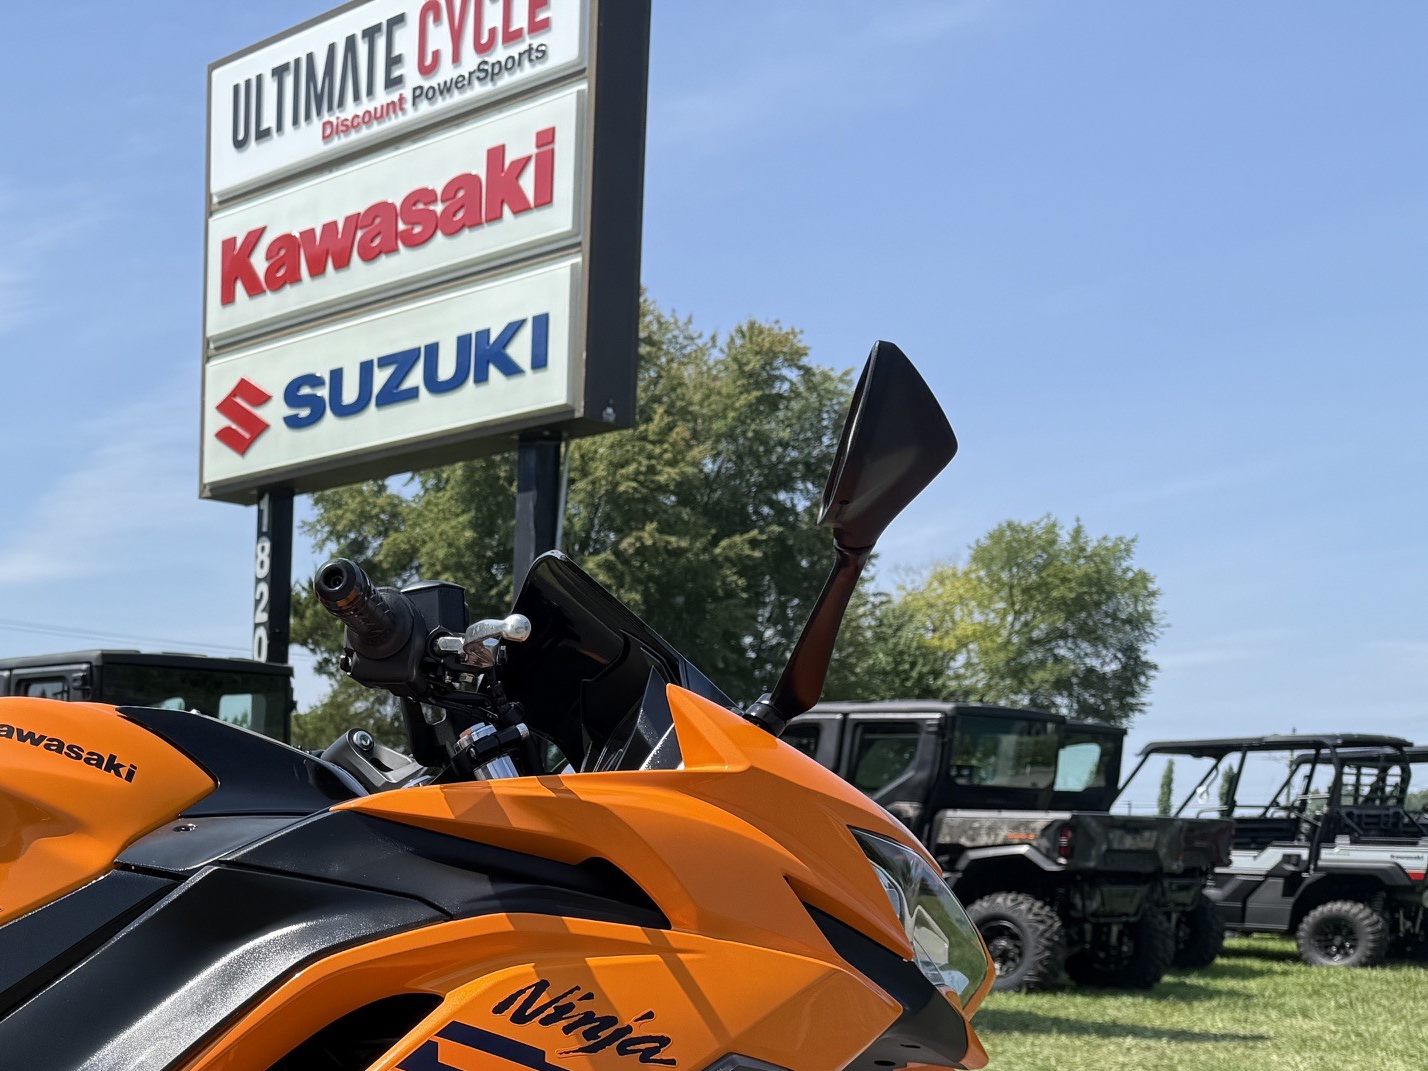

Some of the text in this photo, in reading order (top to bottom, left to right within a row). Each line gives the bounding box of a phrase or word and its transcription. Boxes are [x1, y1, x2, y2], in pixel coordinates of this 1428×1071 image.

[233, 12, 406, 149] ULTIMATE
[322, 42, 548, 141] Discount PowerSports
[220, 126, 556, 305] Kawasaki
[282, 312, 550, 430] SUZUKI
[491, 979, 677, 1066] Ninja
